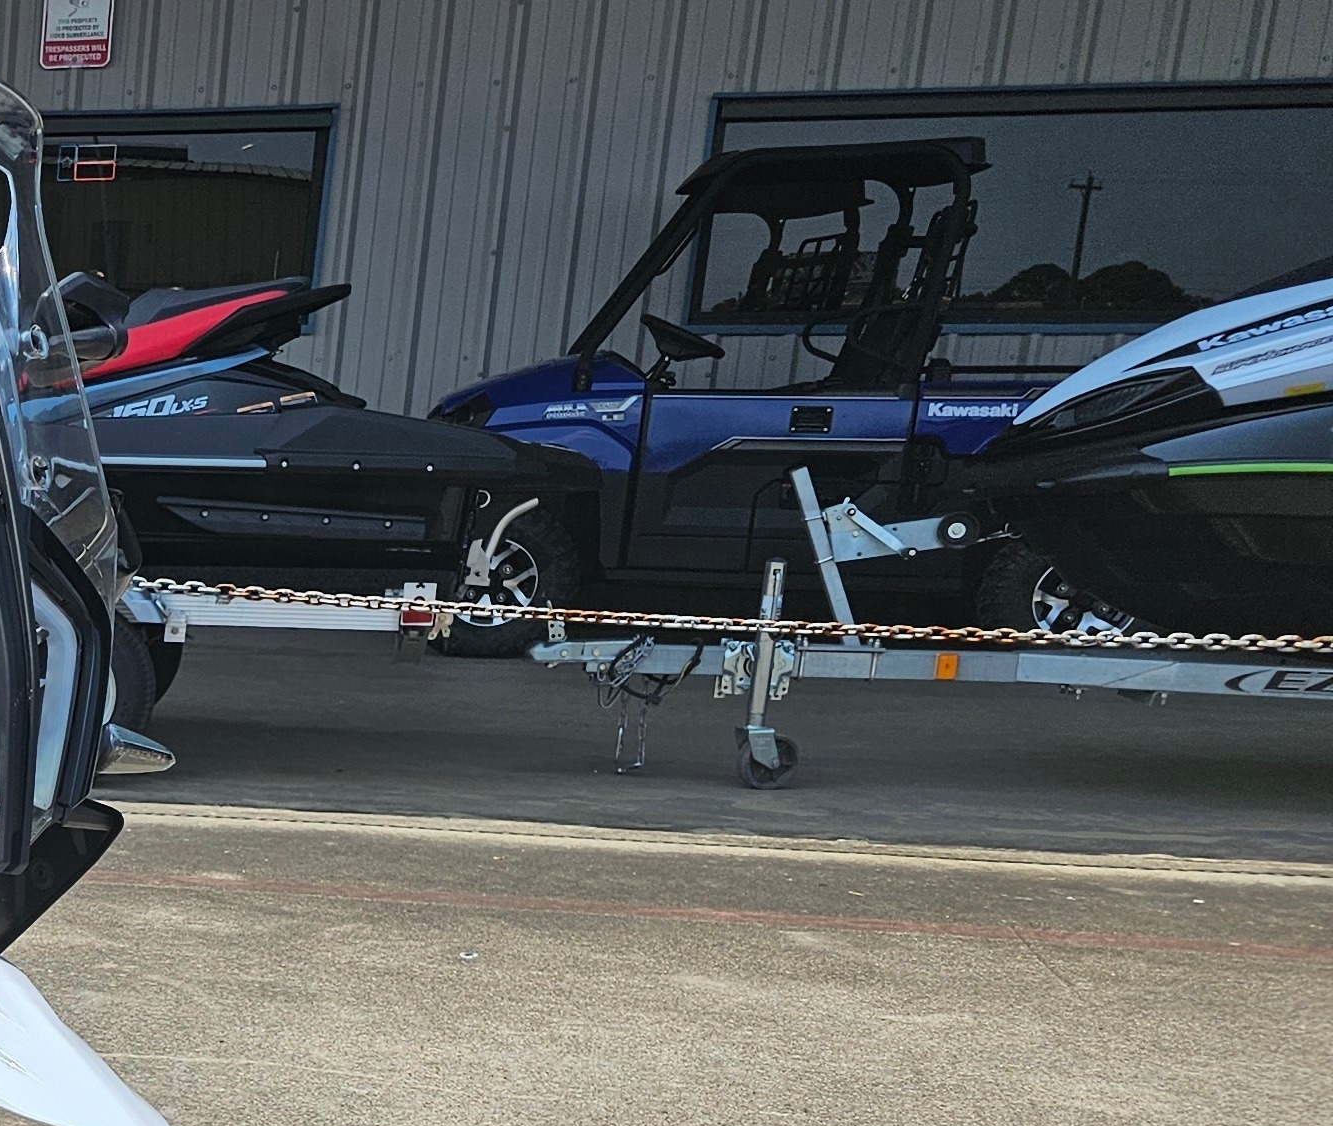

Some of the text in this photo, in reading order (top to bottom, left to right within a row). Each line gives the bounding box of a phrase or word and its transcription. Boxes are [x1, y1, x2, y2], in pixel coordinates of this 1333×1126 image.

[45, 44, 106, 54] TRESPASSERS WILL
[48, 54, 58, 62] BE
[928, 402, 1019, 417] Kawasaki
